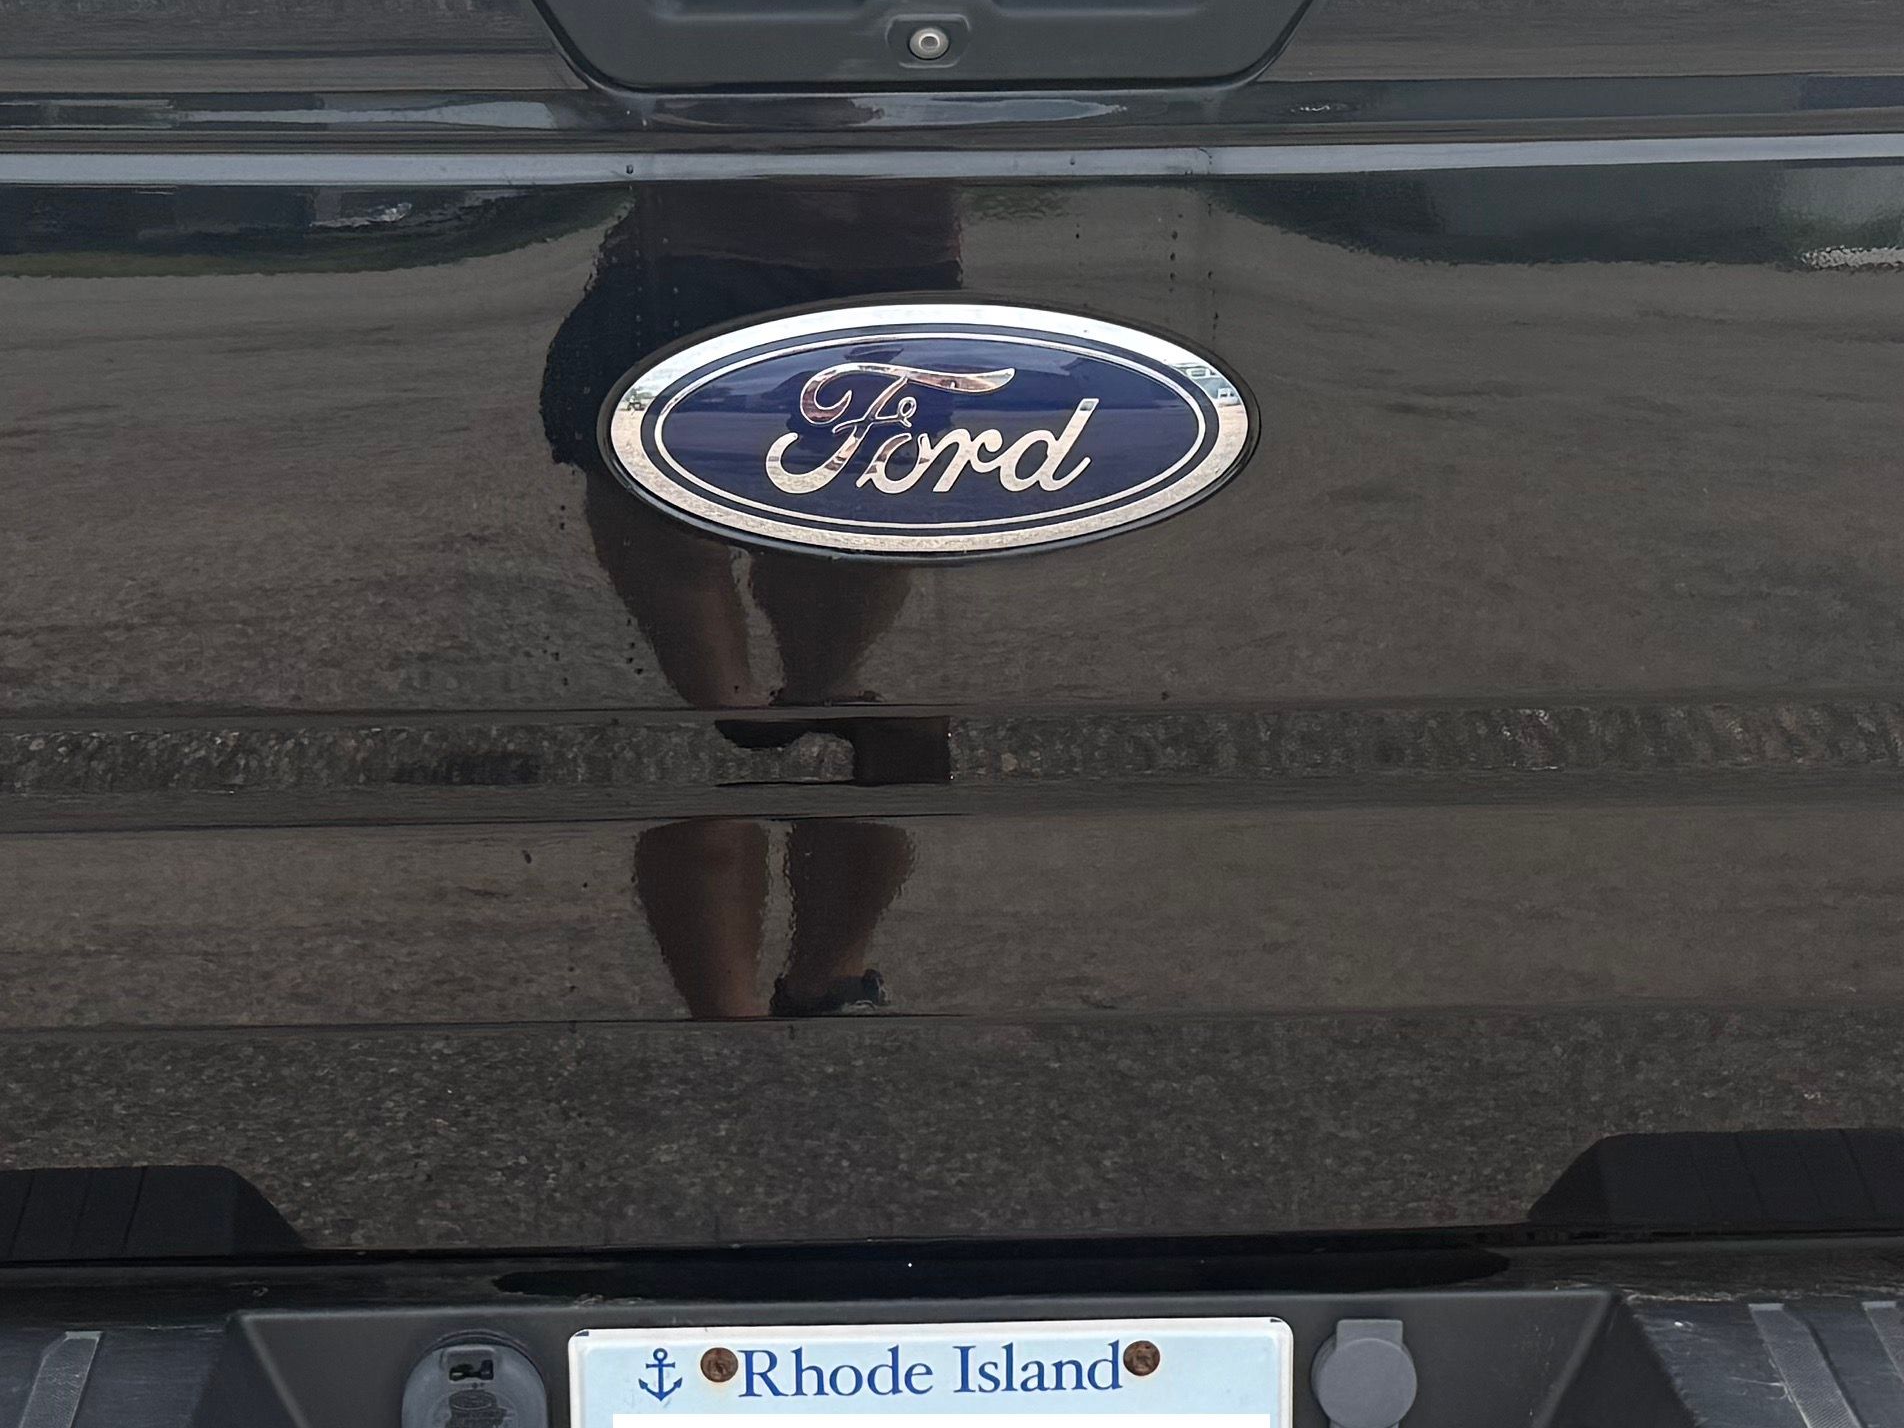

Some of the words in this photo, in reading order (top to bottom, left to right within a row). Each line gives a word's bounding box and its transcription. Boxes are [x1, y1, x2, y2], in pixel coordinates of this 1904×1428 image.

[765, 361, 1099, 495] Ford
[738, 1345, 934, 1398] Rhode
[953, 1339, 1123, 1394] Island
